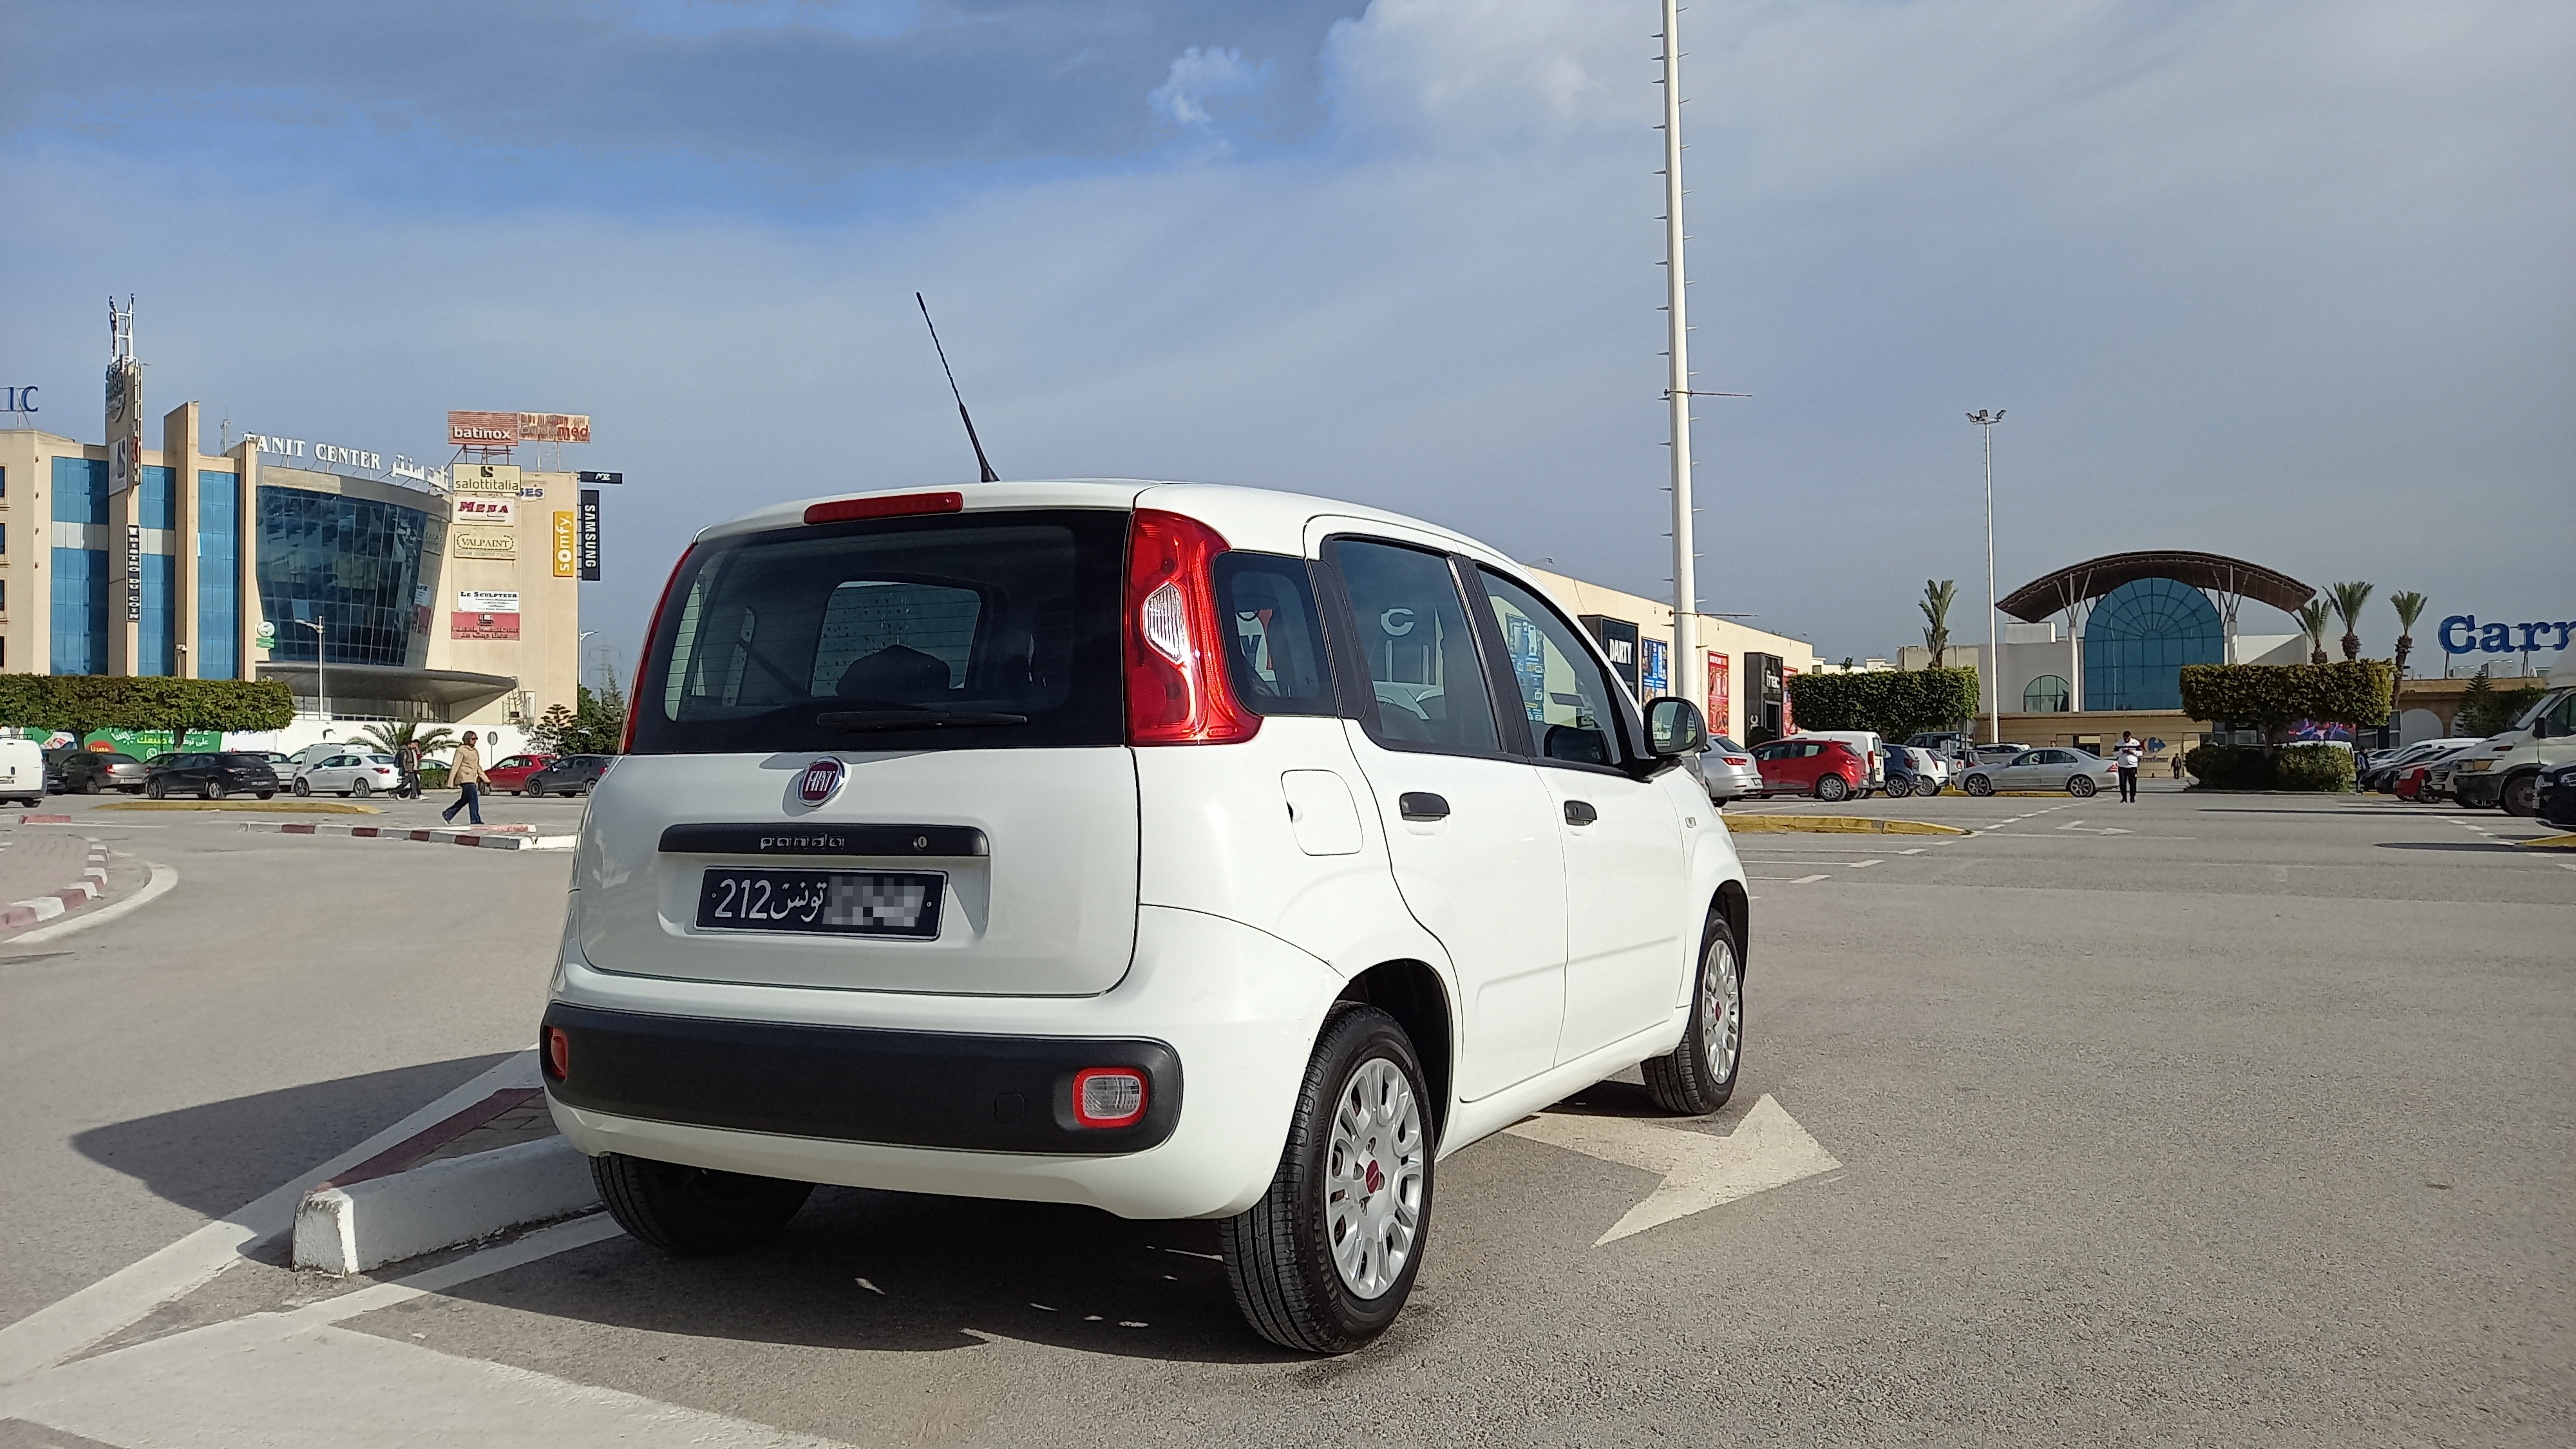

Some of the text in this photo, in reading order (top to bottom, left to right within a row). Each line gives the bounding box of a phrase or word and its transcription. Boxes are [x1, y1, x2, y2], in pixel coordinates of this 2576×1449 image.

[453, 426, 511, 440] batinox
[314, 443, 381, 470] CENTER
[455, 478, 519, 491] salottitalia
[461, 538, 510, 547] VALPAINT
[584, 504, 596, 568] SAMSUNG
[1609, 639, 1632, 665] DARTY
[1766, 670, 1780, 689] fnac
[804, 770, 836, 792] FIAT
[760, 834, 845, 849] panda
[714, 879, 772, 920] 212
[770, 882, 828, 923] تونس
